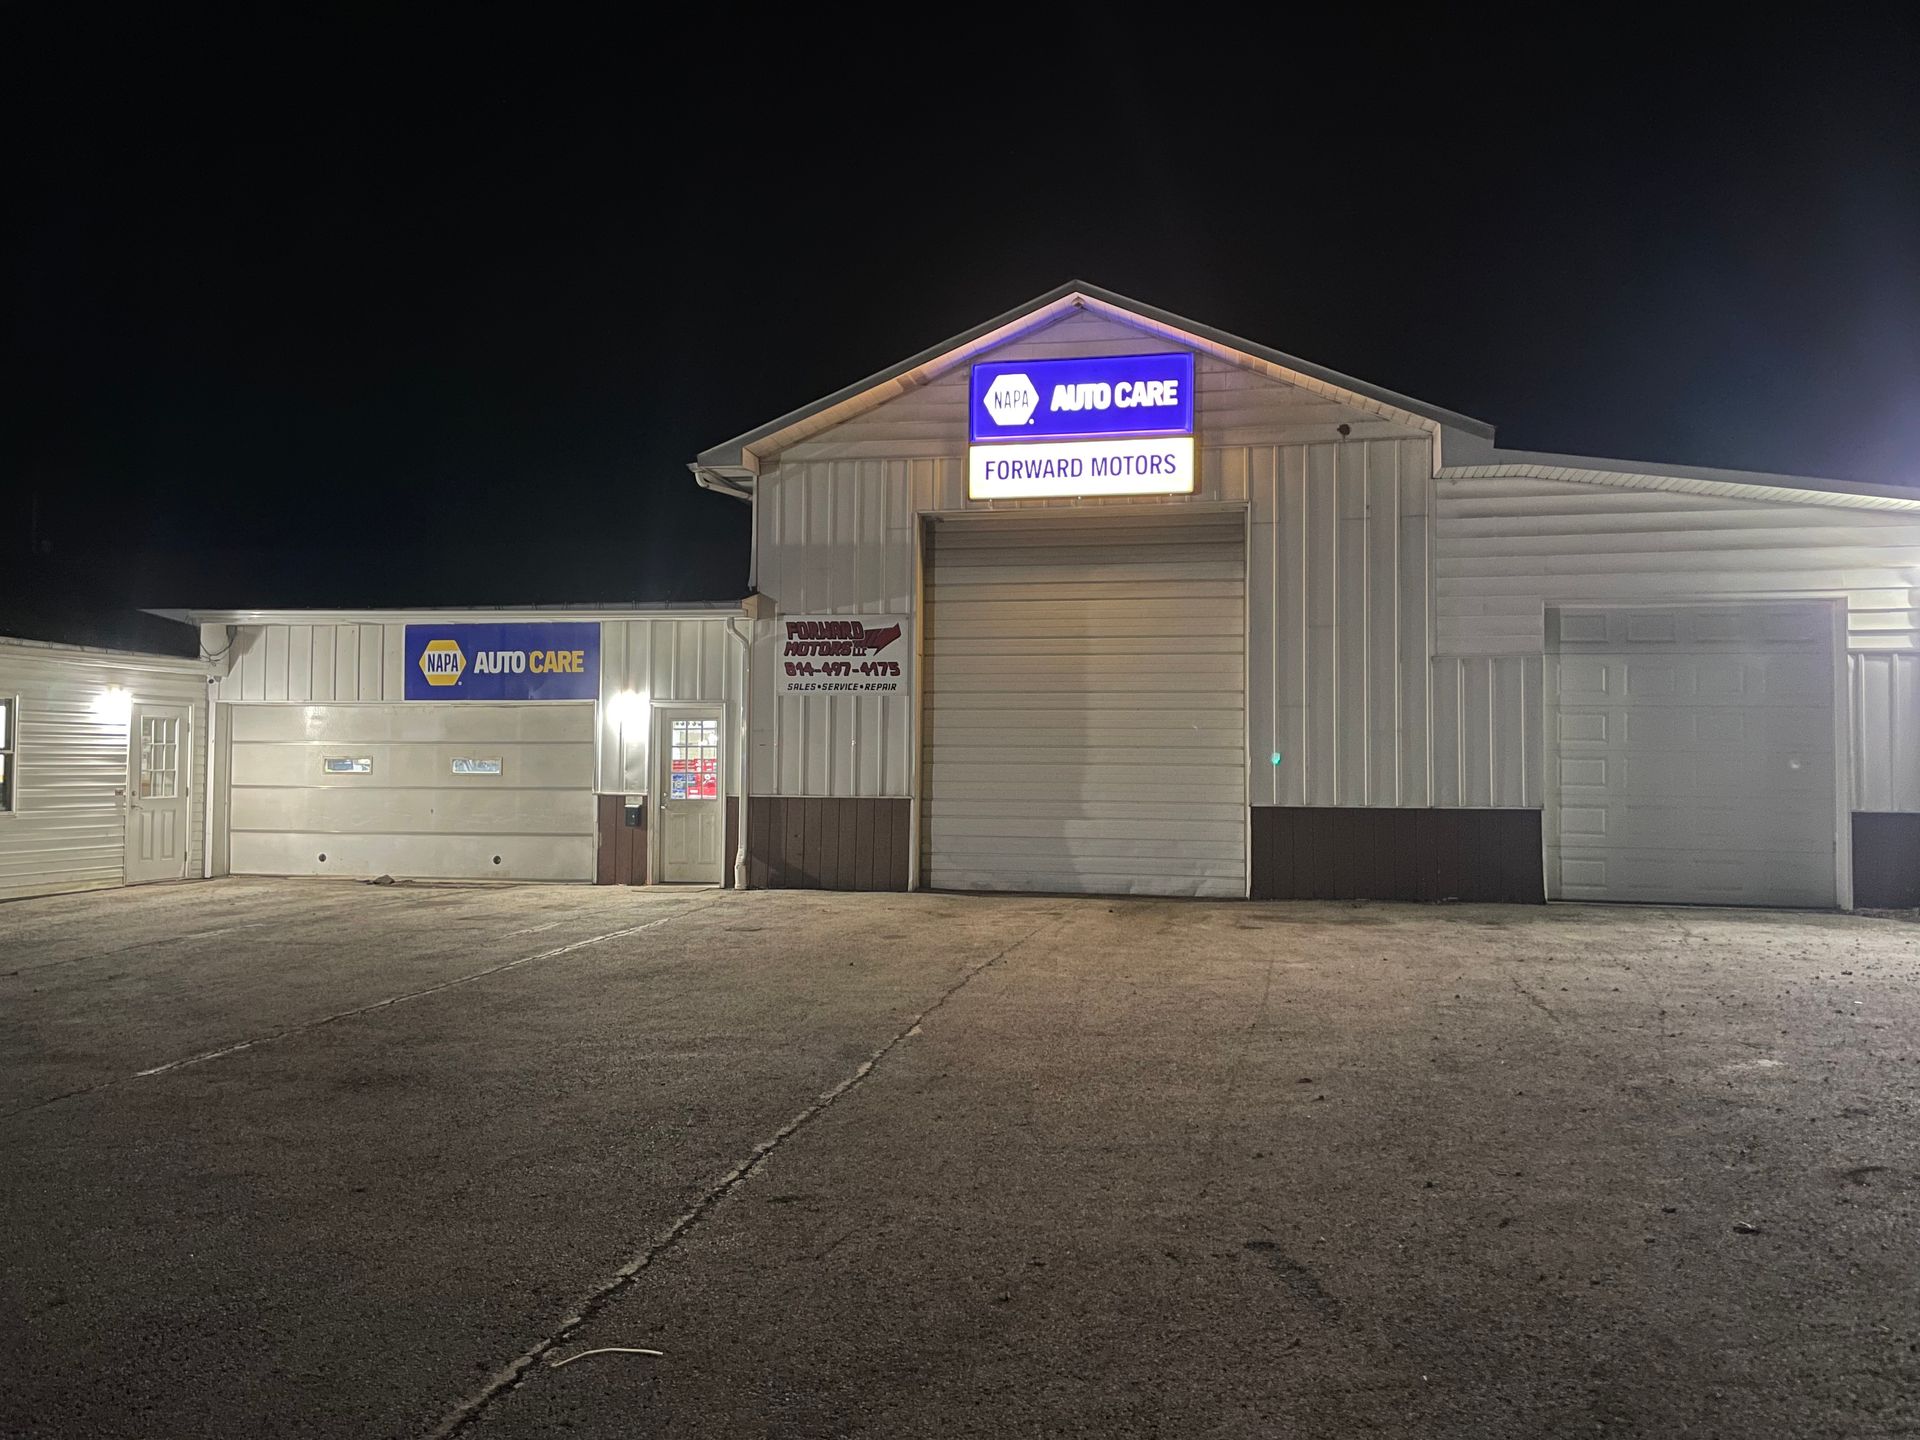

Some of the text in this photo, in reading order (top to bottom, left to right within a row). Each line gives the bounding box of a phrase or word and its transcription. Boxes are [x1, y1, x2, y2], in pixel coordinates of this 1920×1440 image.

[994, 380, 1179, 412] NAPA AUTO CARE
[985, 454, 1176, 481] FORWARD MOTORS
[786, 621, 865, 640] FORWARD
[784, 641, 853, 657] MOTORS
[427, 650, 585, 674] NAPA AUTO CARE
[787, 683, 897, 691] SALES SERVICE REPAIR
